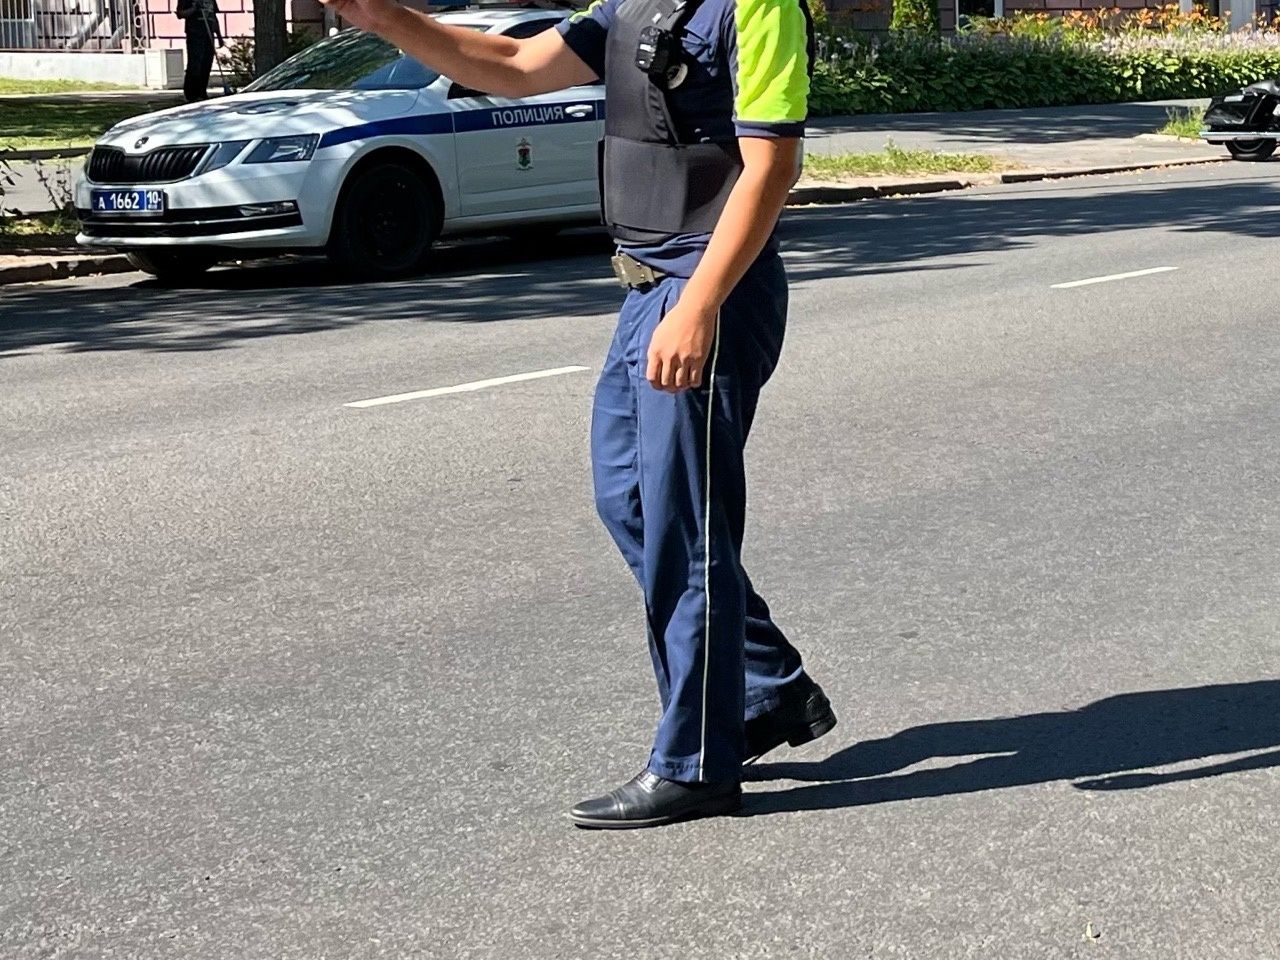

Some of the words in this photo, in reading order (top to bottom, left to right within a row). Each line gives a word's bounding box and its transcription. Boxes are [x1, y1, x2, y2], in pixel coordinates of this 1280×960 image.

[491, 105, 564, 125] ПОЛИЦИЯ
[110, 192, 140, 209] 1662
[147, 191, 159, 204] 10
